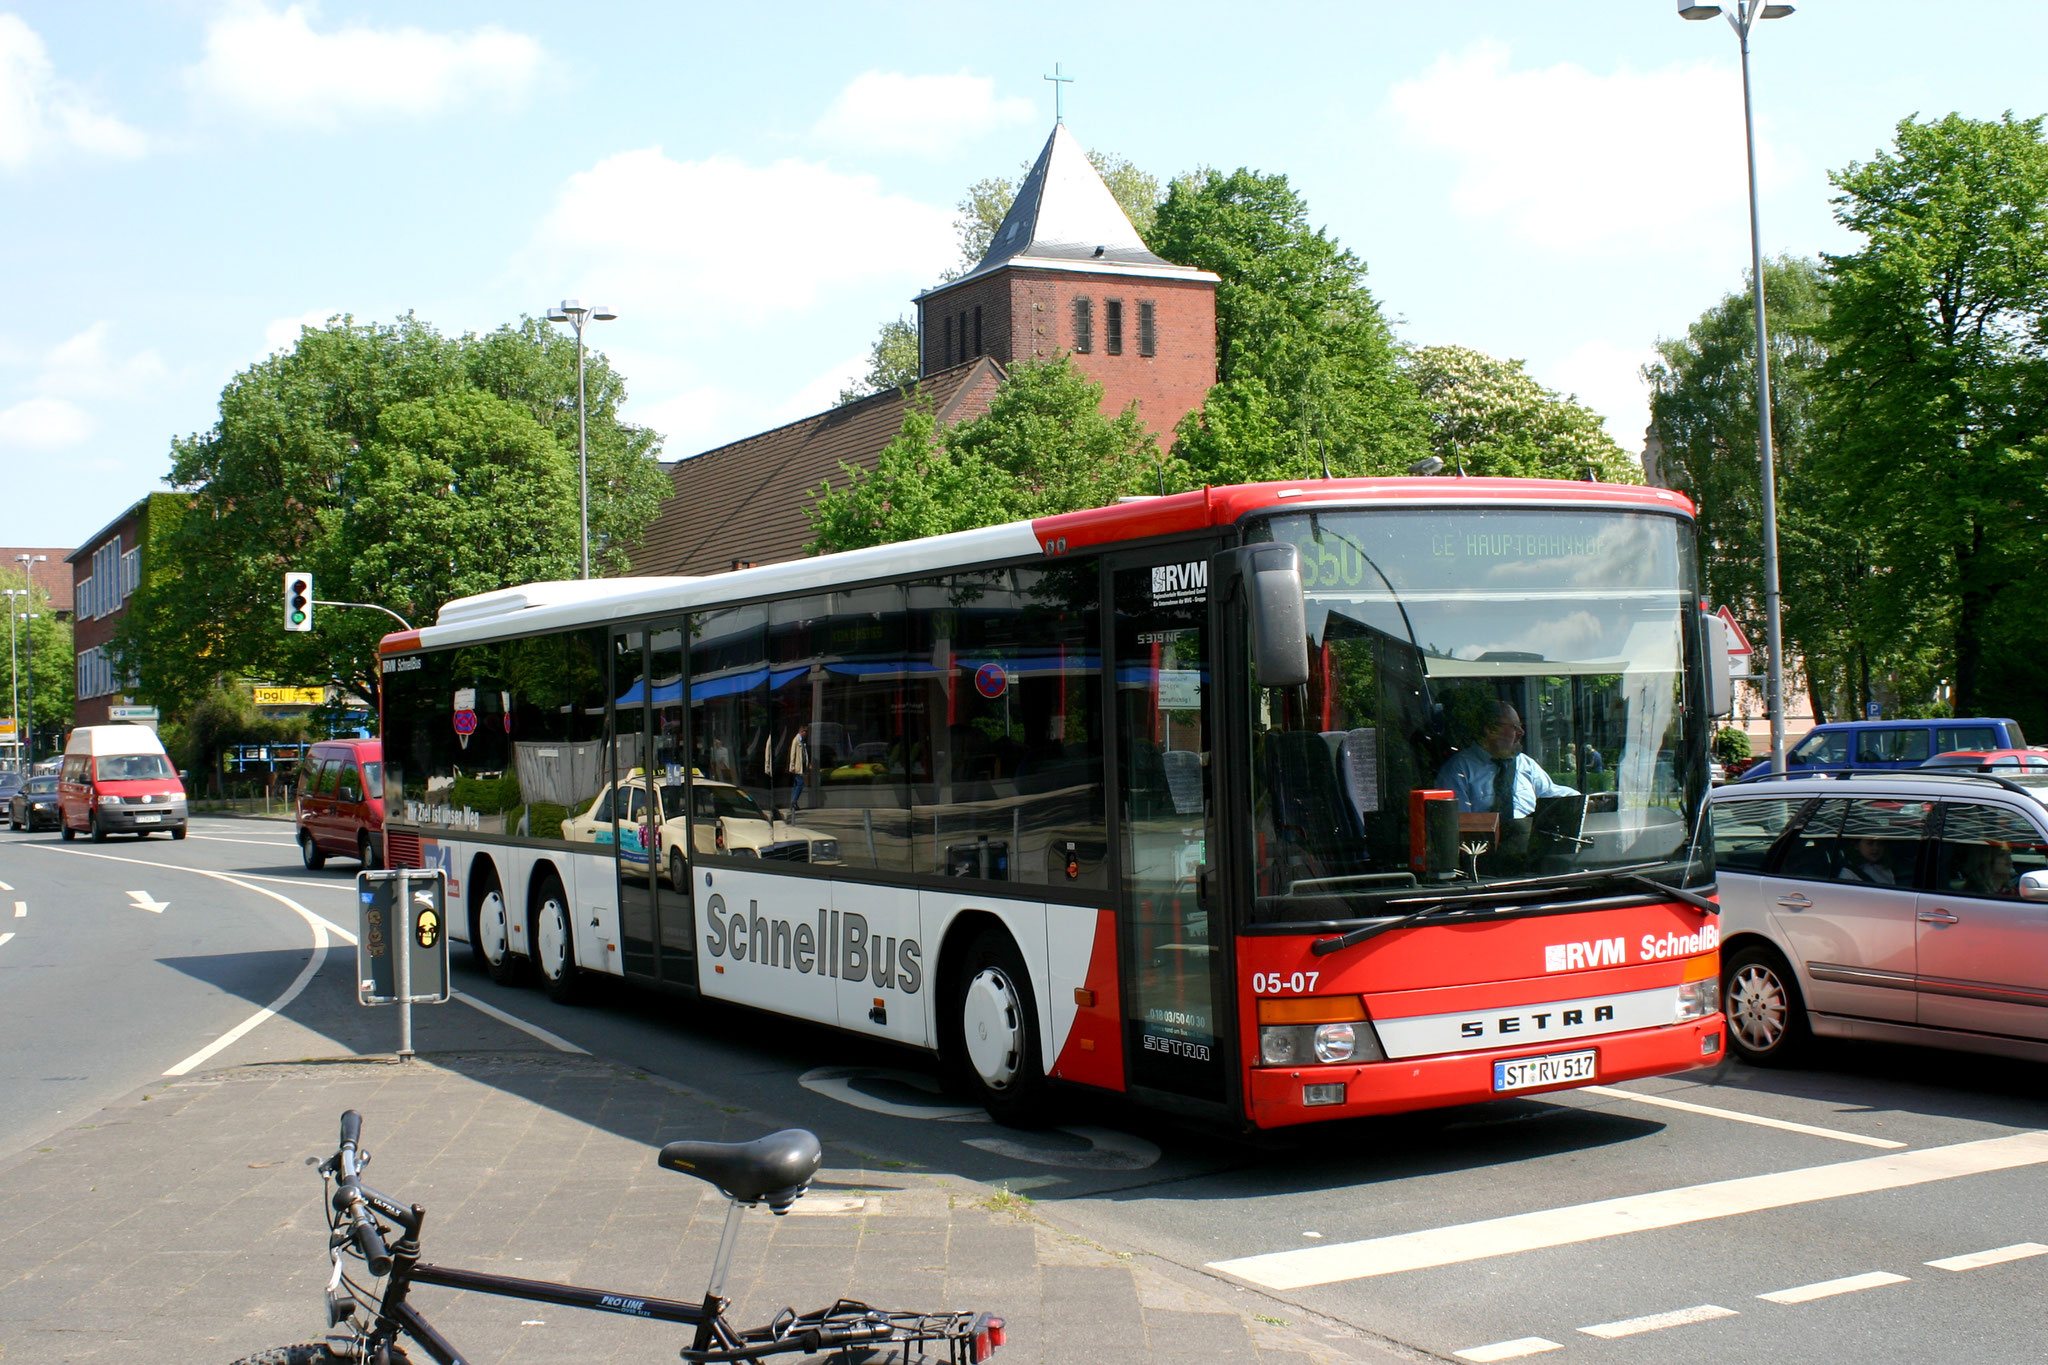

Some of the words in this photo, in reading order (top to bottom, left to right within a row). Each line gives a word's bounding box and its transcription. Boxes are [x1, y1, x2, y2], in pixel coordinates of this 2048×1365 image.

[1300, 533, 1363, 587] S50
[1166, 560, 1208, 591] RVM
[418, 802, 431, 823] Ziel
[463, 804, 479, 831] Weg
[706, 893, 922, 994] SchnellBus
[1567, 937, 1626, 970] RVM
[1253, 971, 1320, 994] 05-07
[1461, 1005, 1614, 1038] SETRA
[1143, 1034, 1210, 1062] SETRA
[1507, 1065, 1528, 1086] ST
[1539, 1060, 1560, 1082] RV
[1564, 1056, 1593, 1078] 517
[601, 1295, 622, 1307] PRO
[621, 1299, 646, 1311] LINE
